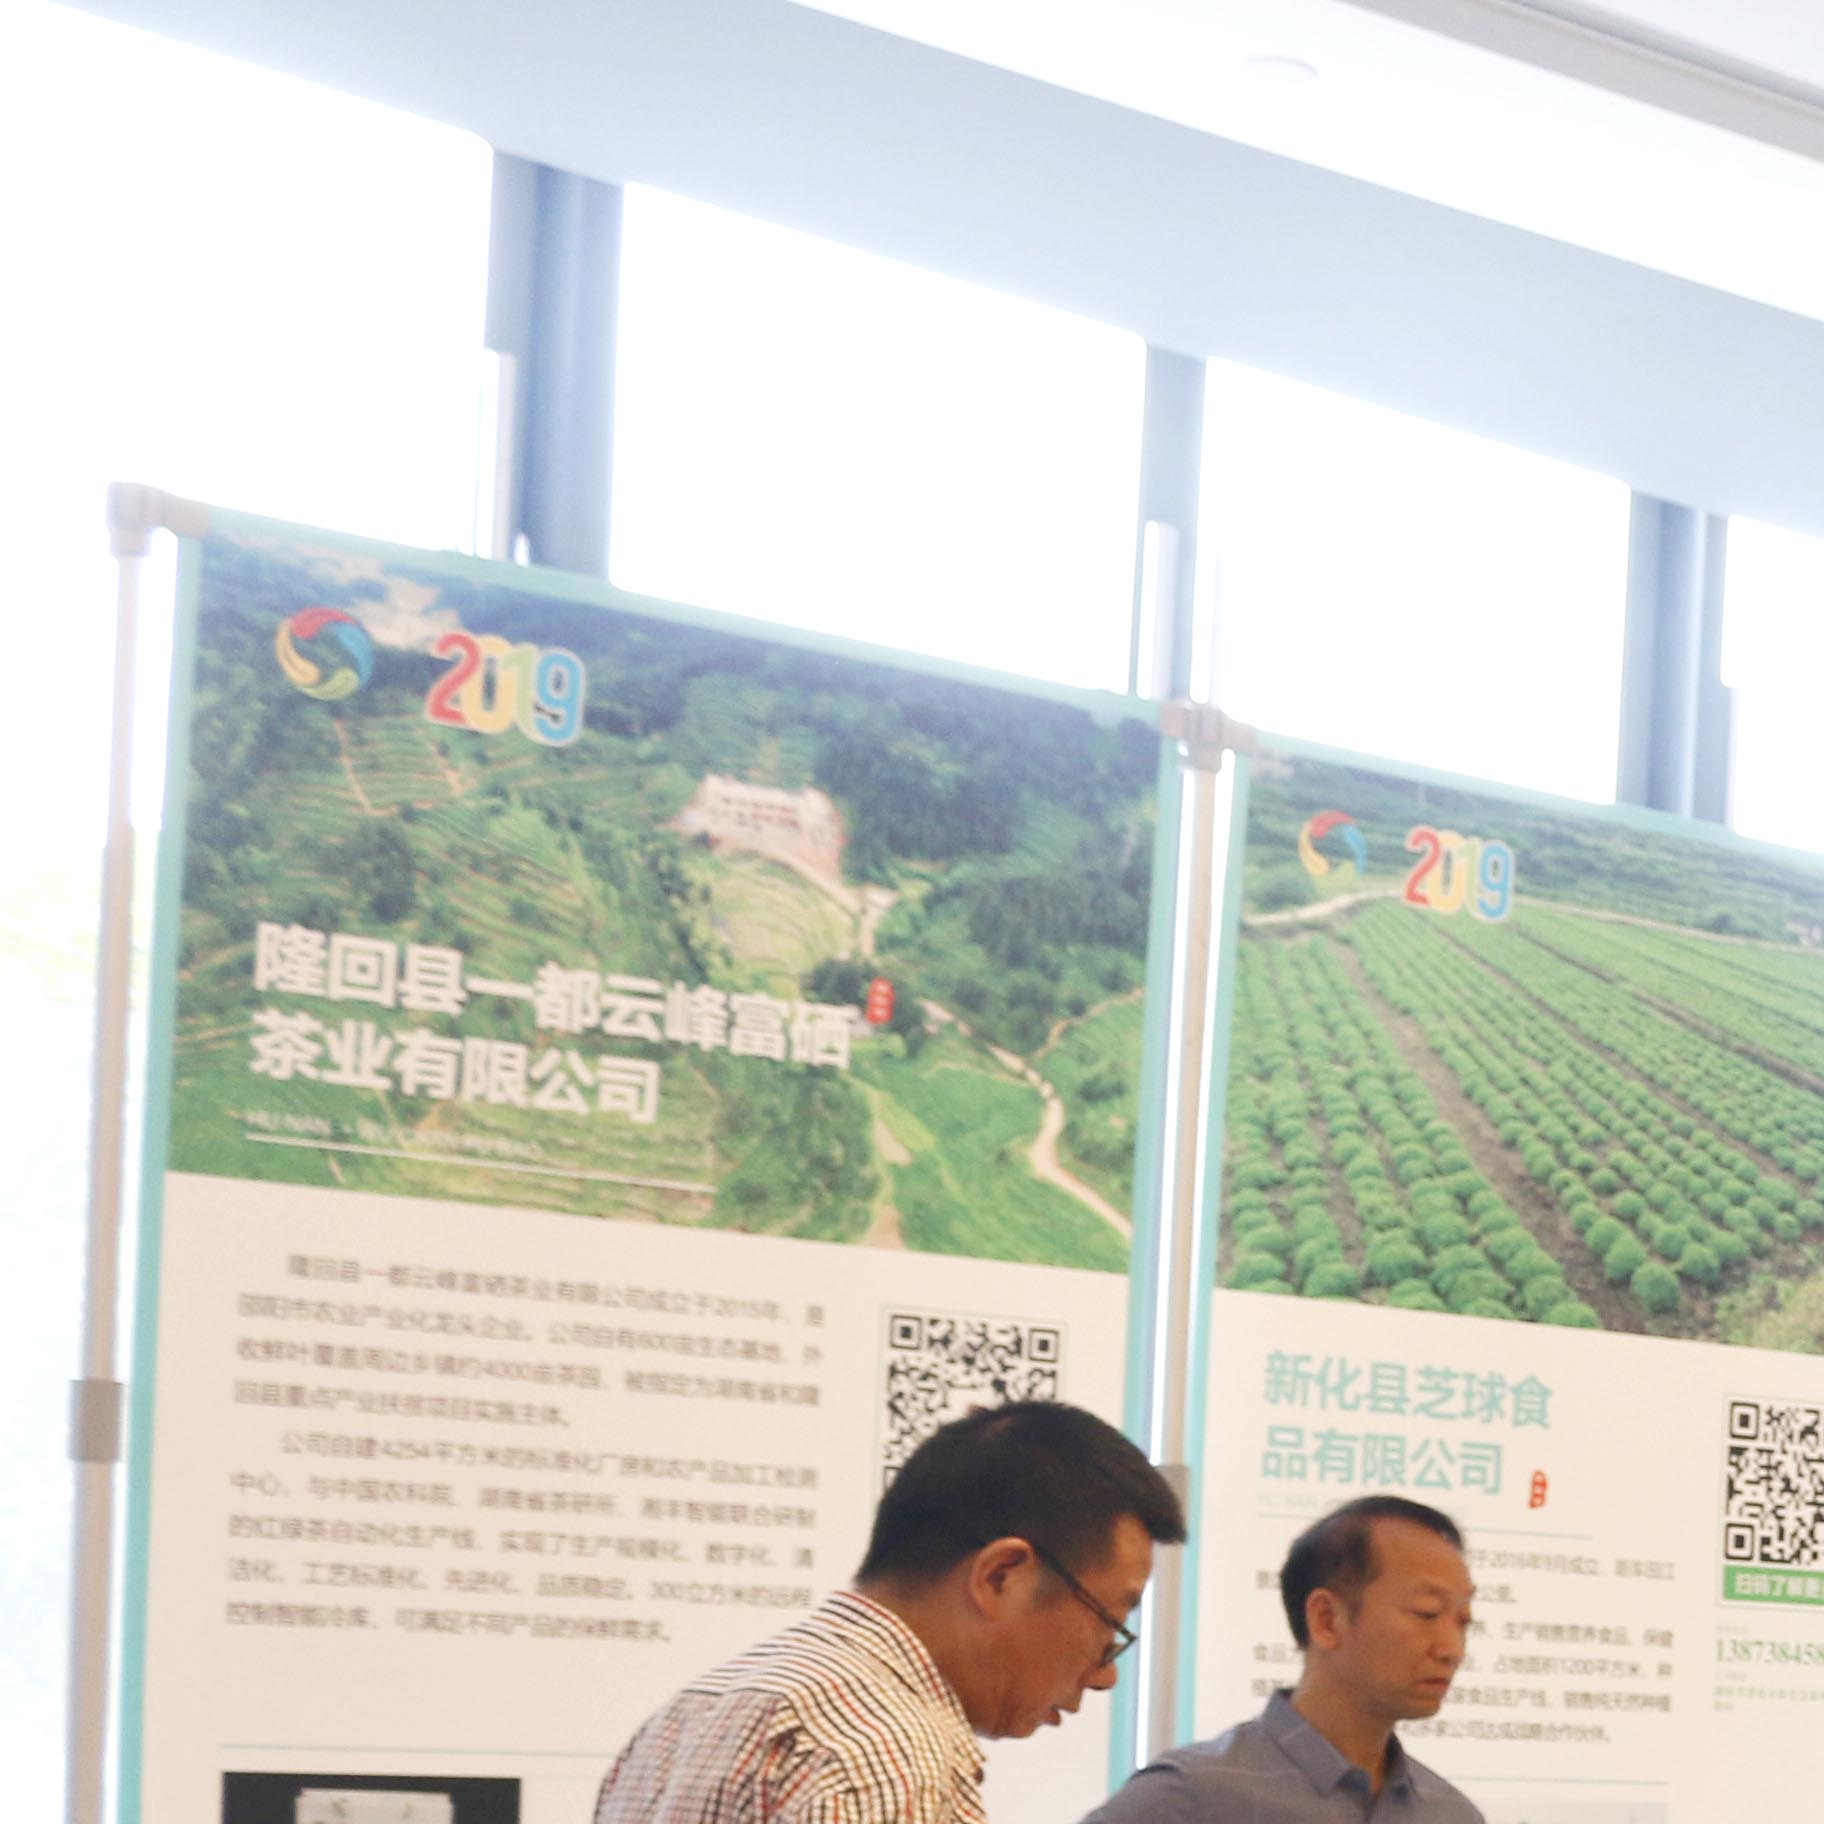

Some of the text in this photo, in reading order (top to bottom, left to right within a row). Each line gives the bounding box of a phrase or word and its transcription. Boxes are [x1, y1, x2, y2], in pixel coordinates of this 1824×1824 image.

[426, 633, 586, 747] 2019
[1401, 824, 1517, 924] 2019
[254, 922, 854, 1070] 隆回县一都云峰富硒
[249, 1010, 664, 1126] 茶业有限公司
[1264, 1347, 1552, 1432] 新化县芝球食
[1260, 1425, 1505, 1497] 品有限公司
